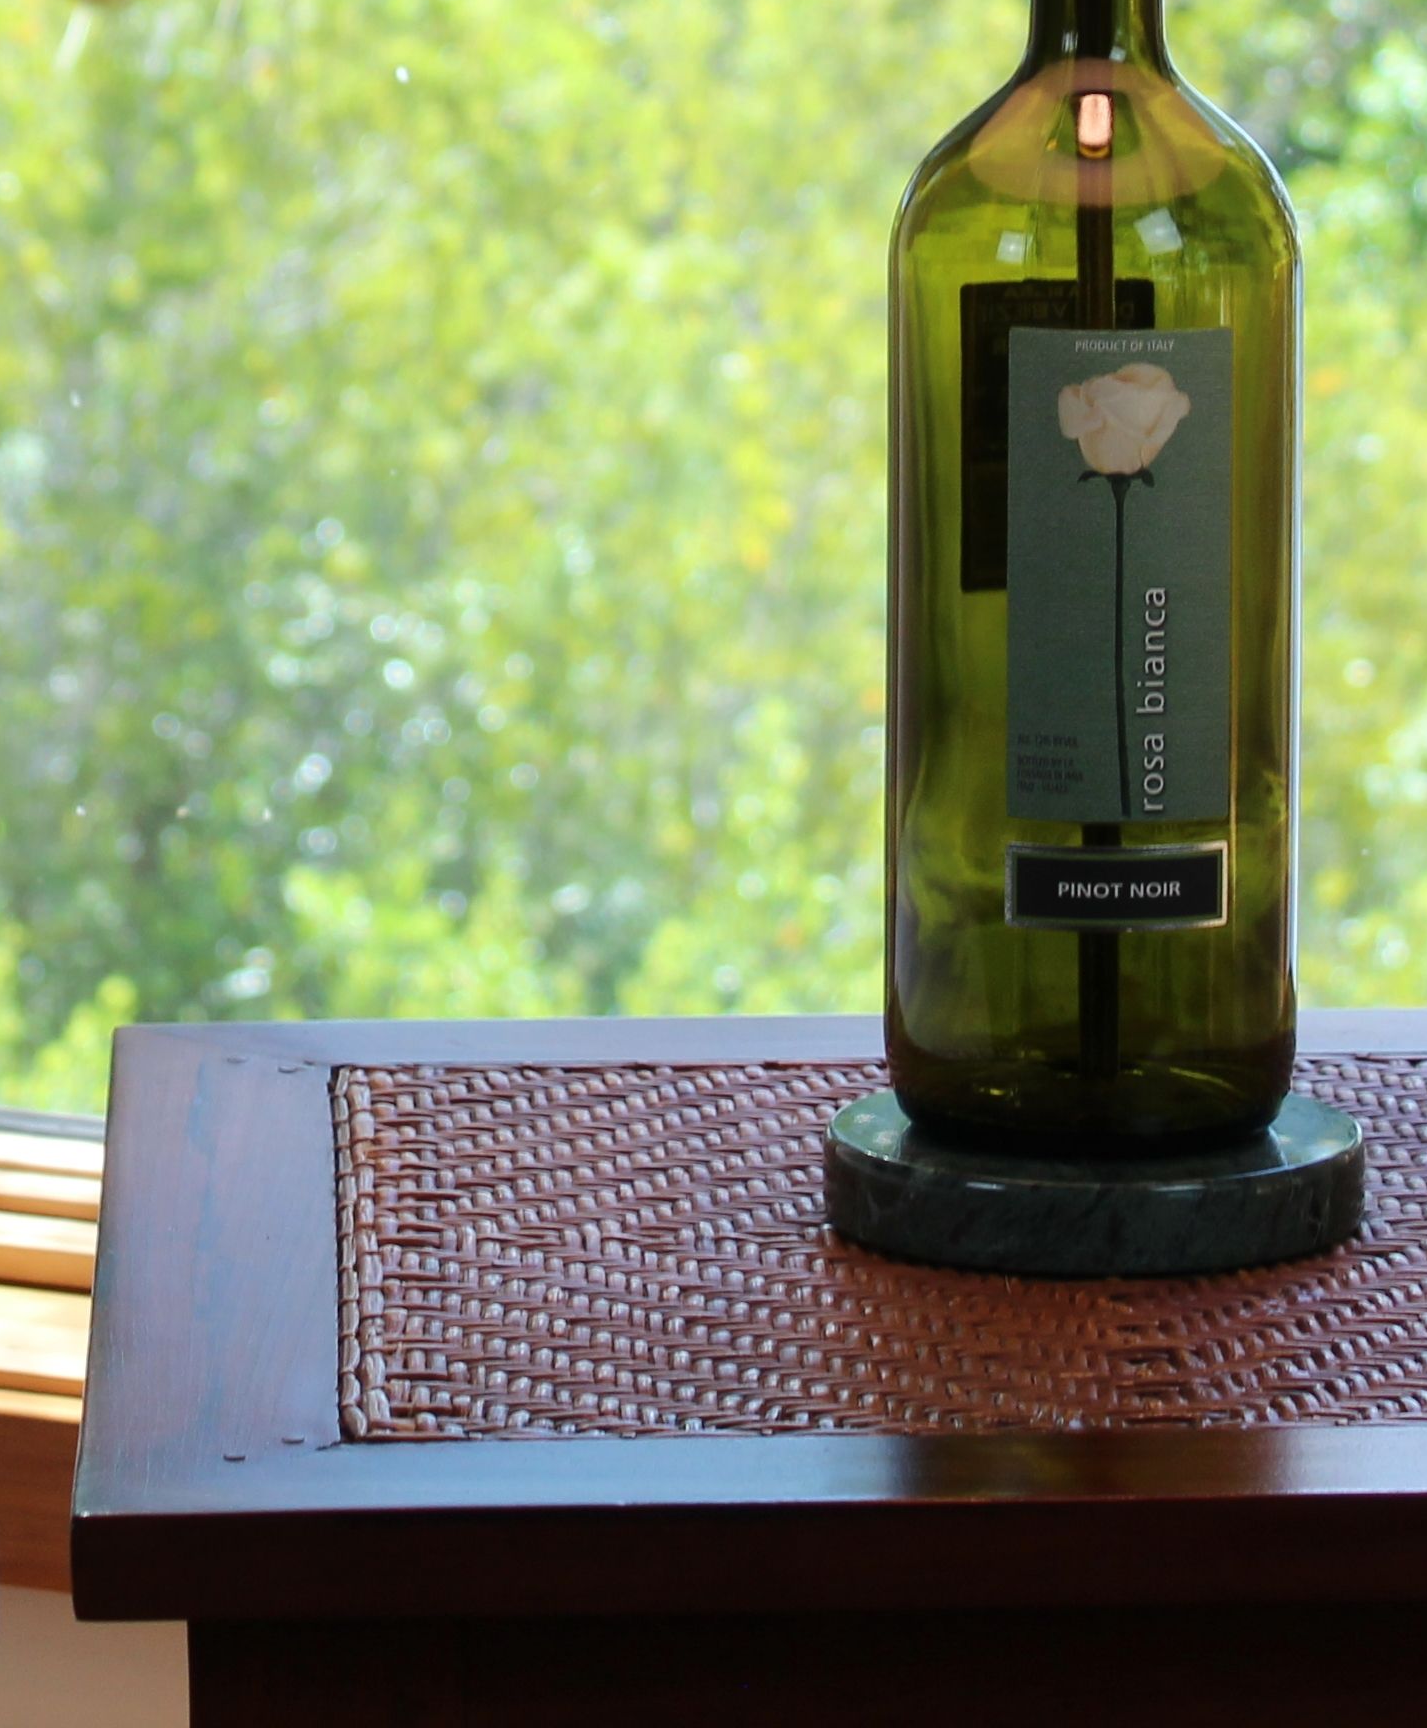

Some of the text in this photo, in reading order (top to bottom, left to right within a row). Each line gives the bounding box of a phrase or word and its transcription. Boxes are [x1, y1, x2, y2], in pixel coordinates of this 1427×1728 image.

[1075, 339, 1175, 352] PRODUCT OF ITALY
[1136, 587, 1166, 812] rosa bianca
[1057, 880, 1181, 899] PINOT NOIR
